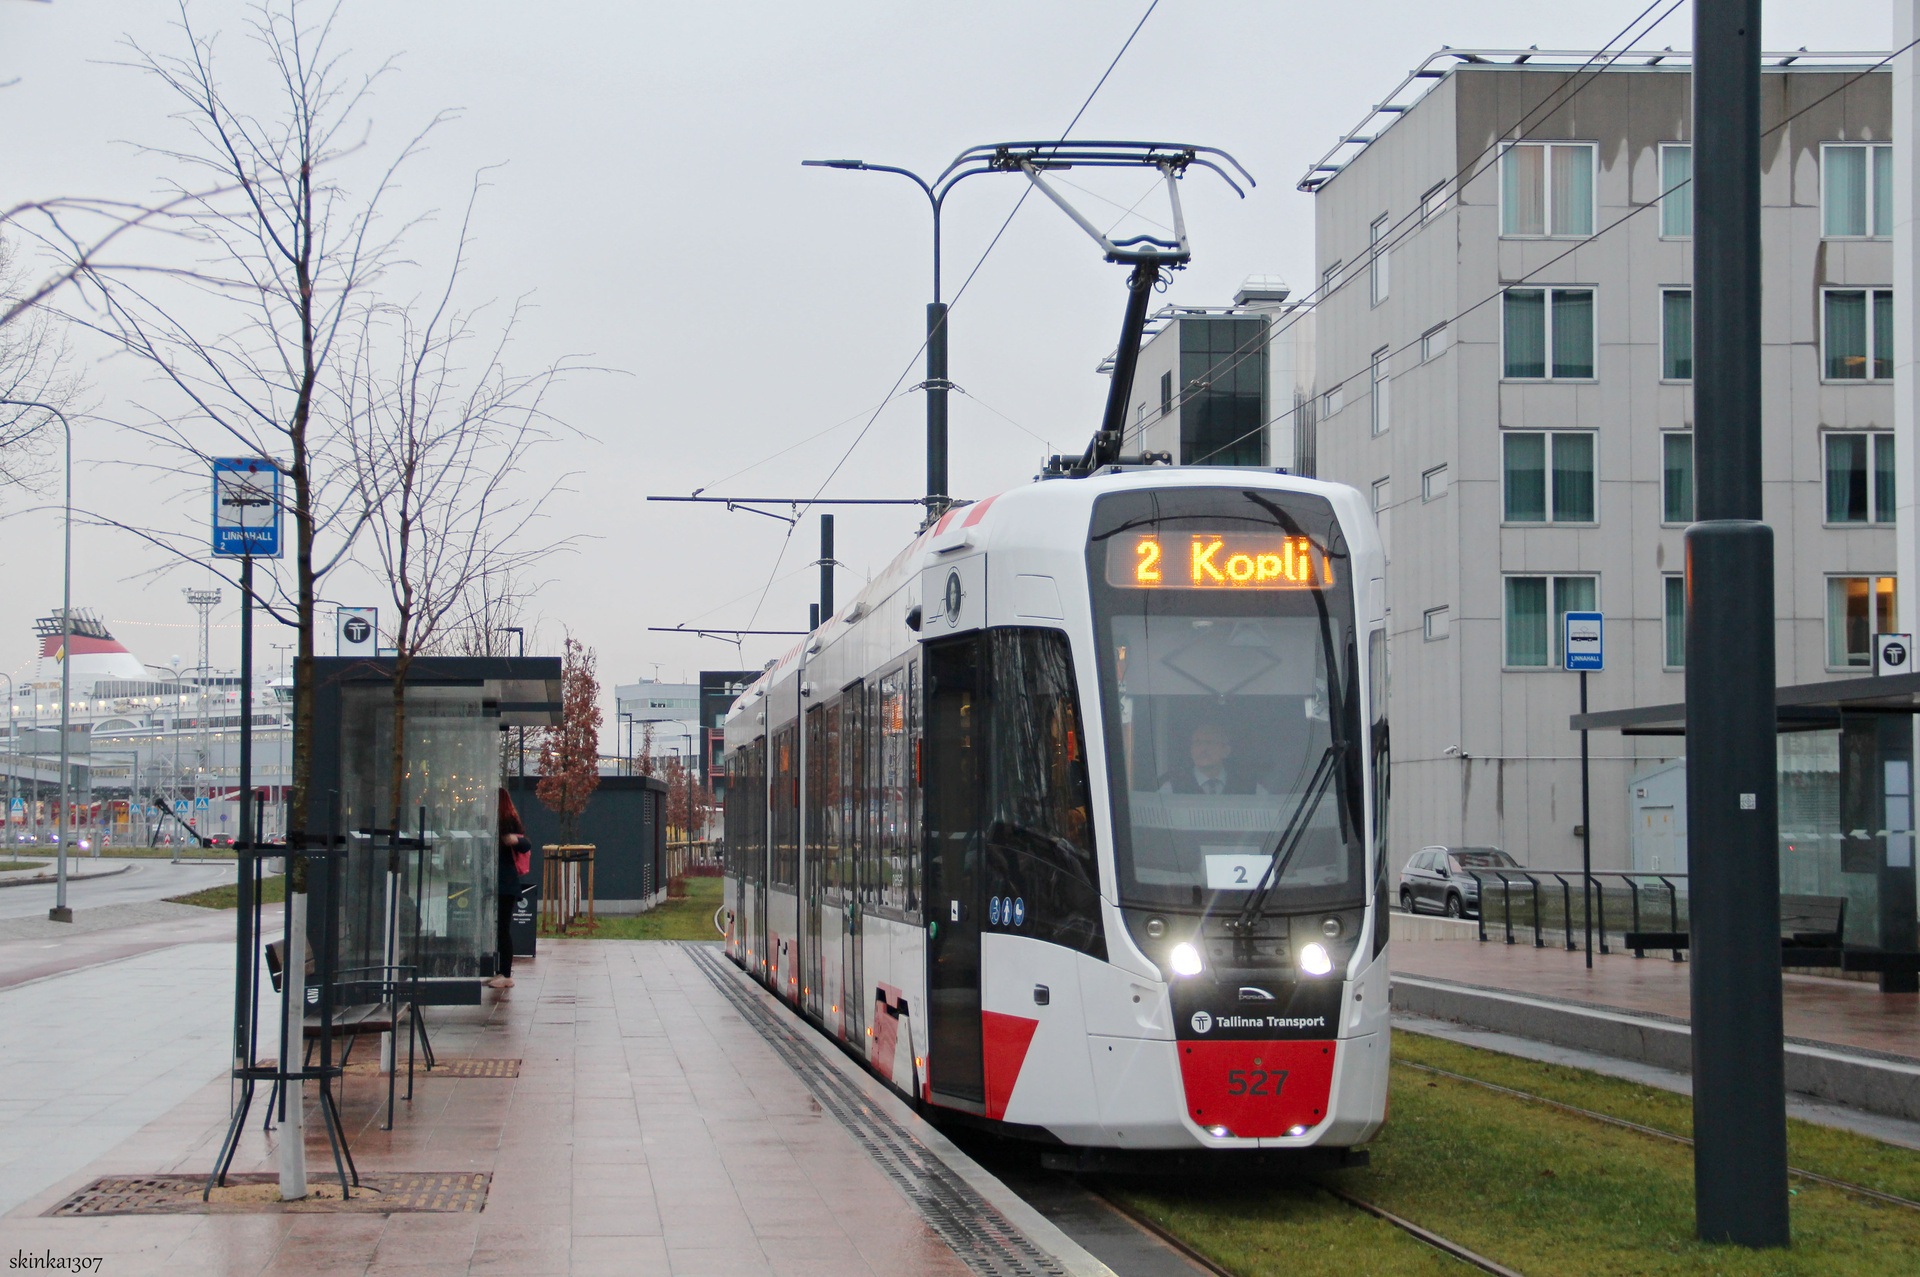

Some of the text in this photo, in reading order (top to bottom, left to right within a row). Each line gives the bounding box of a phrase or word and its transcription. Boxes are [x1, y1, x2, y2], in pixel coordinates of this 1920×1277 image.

[222, 531, 272, 541] LINNAHALL
[220, 542, 226, 550] 2
[1136, 540, 1311, 581] 2 Kopli
[1233, 865, 1249, 884] 2
[1216, 1016, 1325, 1029] Tallinna Transport
[1228, 1069, 1290, 1096] 527
